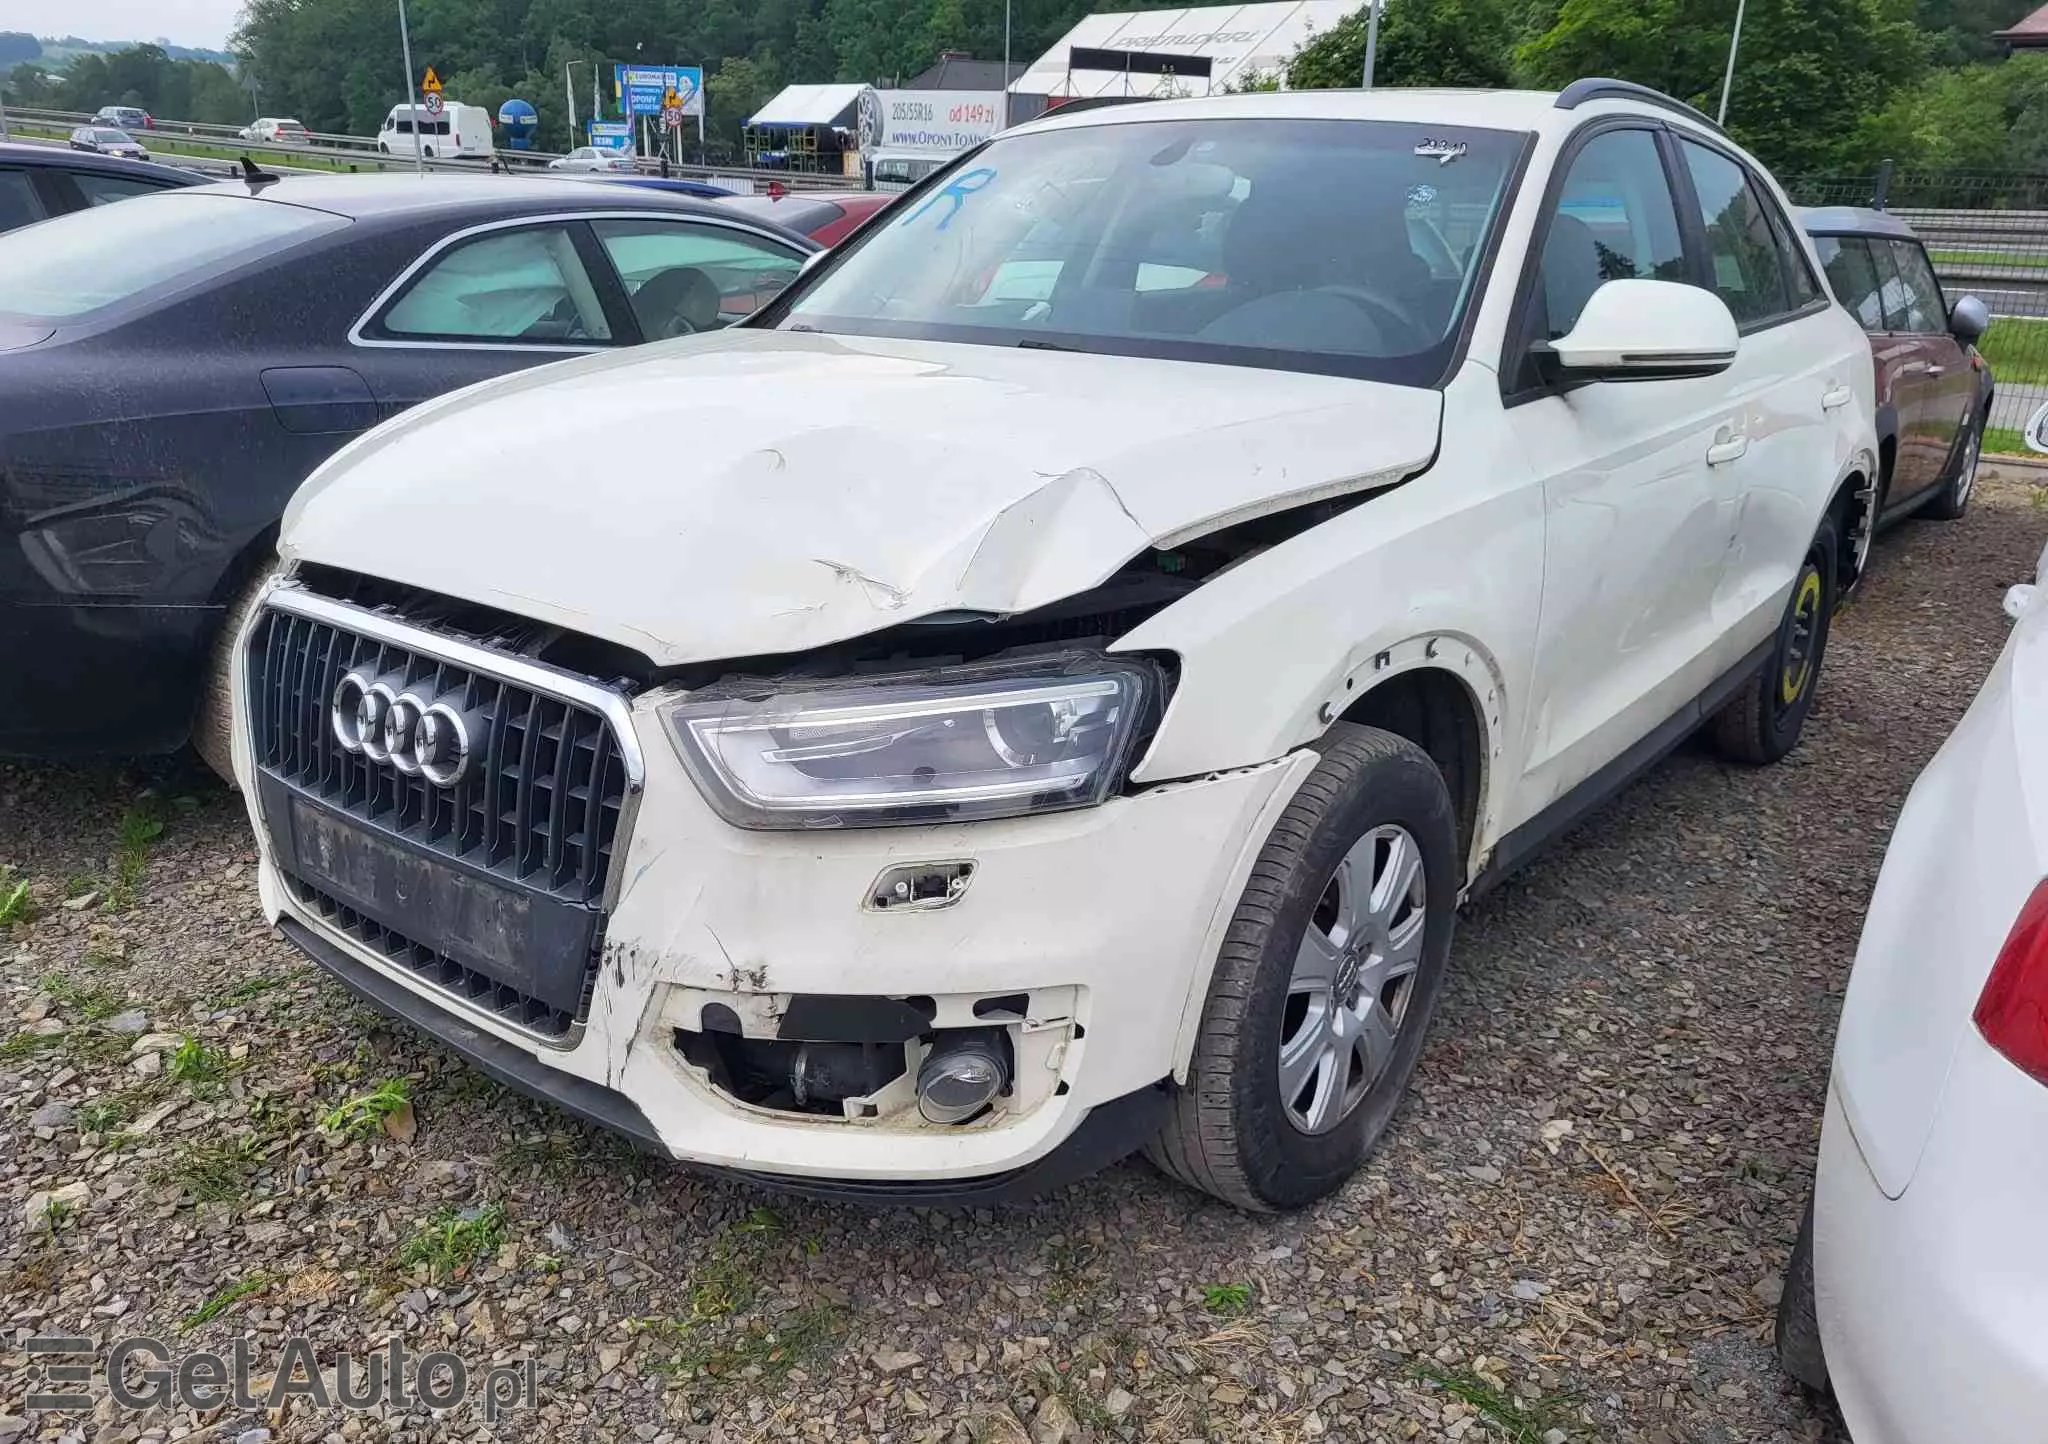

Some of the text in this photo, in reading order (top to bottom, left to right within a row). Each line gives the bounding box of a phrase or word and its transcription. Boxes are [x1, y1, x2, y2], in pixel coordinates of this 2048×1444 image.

[427, 96, 441, 109] 50
[668, 111, 679, 119] 50
[949, 104, 962, 122] od
[965, 104, 984, 122] 149
